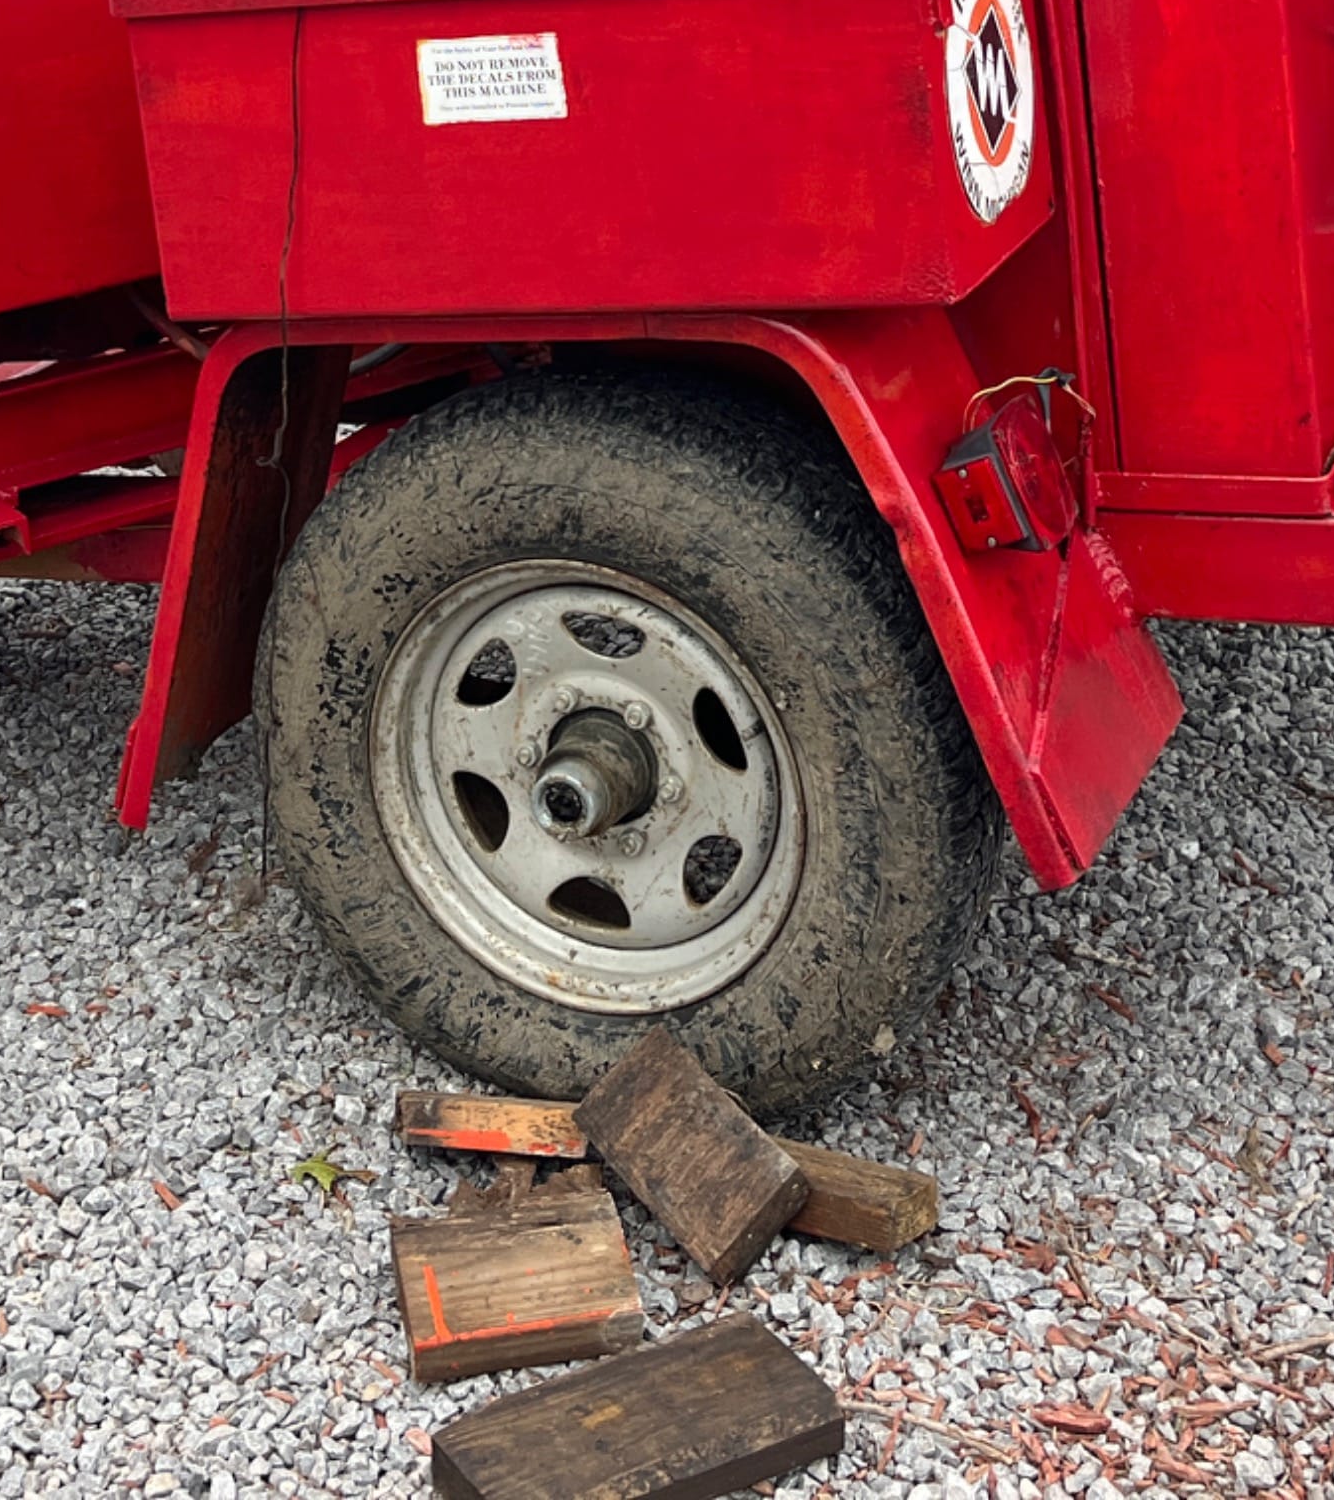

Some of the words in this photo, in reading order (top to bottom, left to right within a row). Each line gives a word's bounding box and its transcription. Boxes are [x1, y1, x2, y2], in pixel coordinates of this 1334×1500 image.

[435, 61, 454, 72] DO
[458, 60, 486, 71] NOT
[489, 57, 549, 69] REMOVE
[427, 75, 457, 86] THE
[458, 72, 514, 85] DECALS
[518, 69, 557, 81] FROM
[443, 87, 475, 99] THIS
[480, 83, 546, 96] MACHINE
